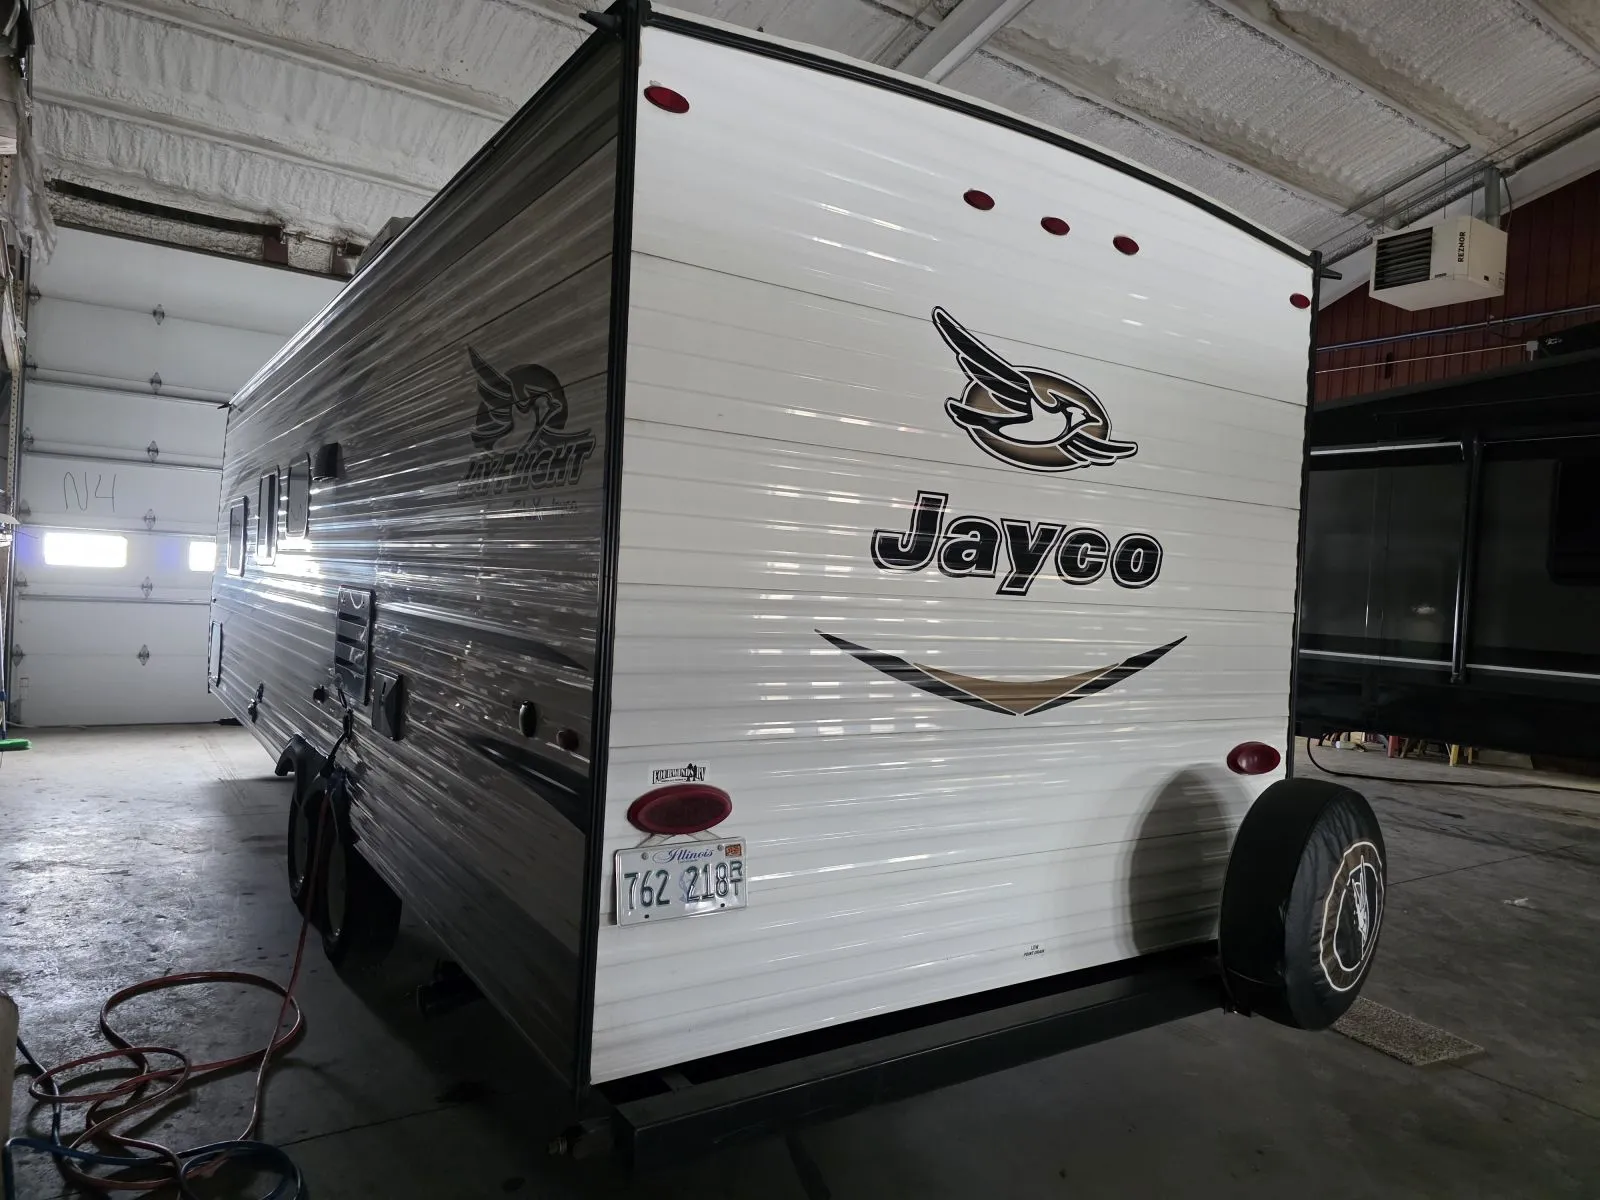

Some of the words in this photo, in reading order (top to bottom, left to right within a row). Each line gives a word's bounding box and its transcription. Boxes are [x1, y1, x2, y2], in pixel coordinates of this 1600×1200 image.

[1457, 231, 1466, 263] REZNOR
[870, 490, 1163, 596] Jayco
[654, 847, 715, 864] Illinois
[624, 869, 671, 910] 762
[685, 862, 729, 903] 218
